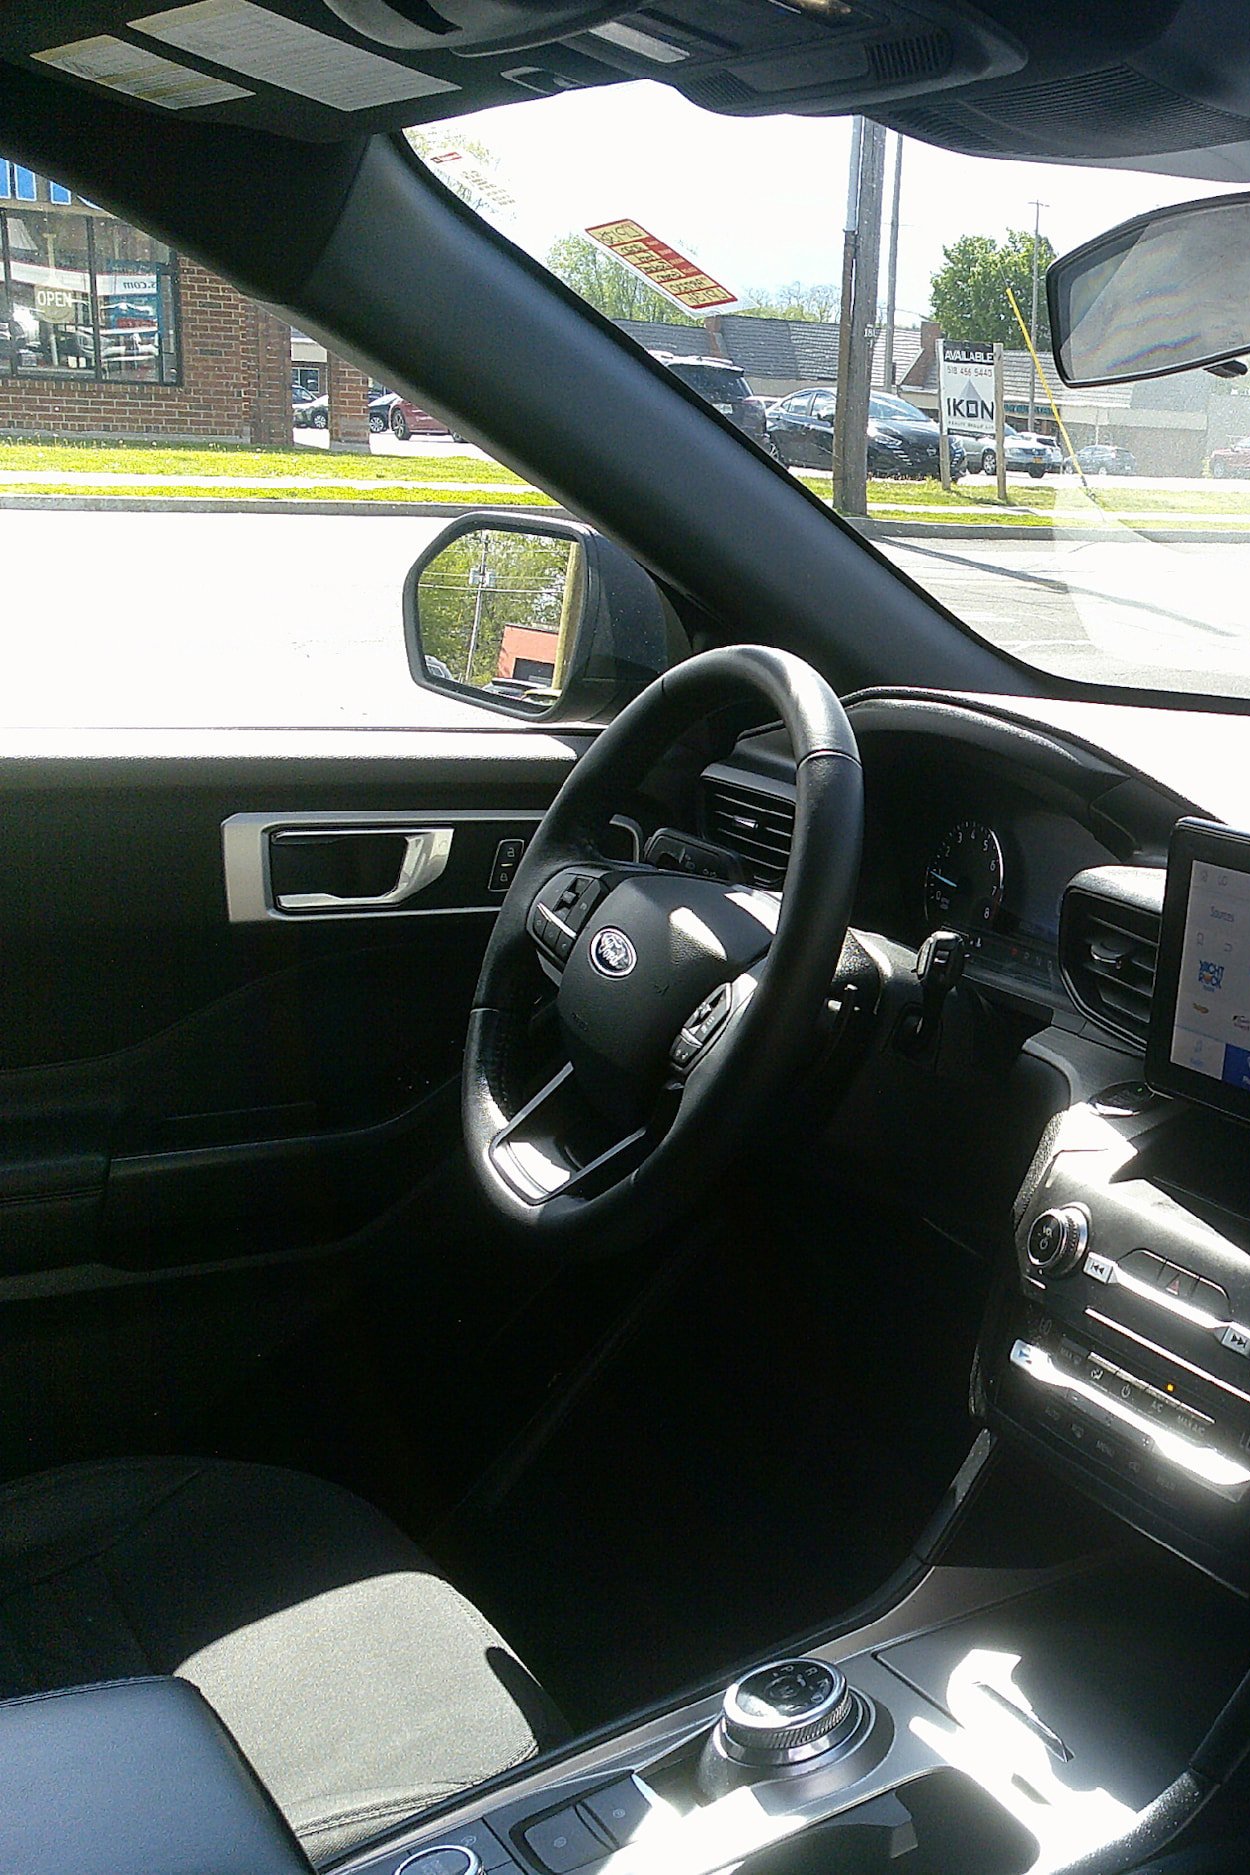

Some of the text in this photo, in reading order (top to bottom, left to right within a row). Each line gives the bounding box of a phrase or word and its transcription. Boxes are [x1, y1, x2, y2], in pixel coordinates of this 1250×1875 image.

[37, 290, 73, 308] OPEN
[944, 349, 994, 363] AVAILABLE
[946, 397, 995, 421] IKON
[597, 931, 629, 969] Ford
[780, 1664, 795, 1673] P
